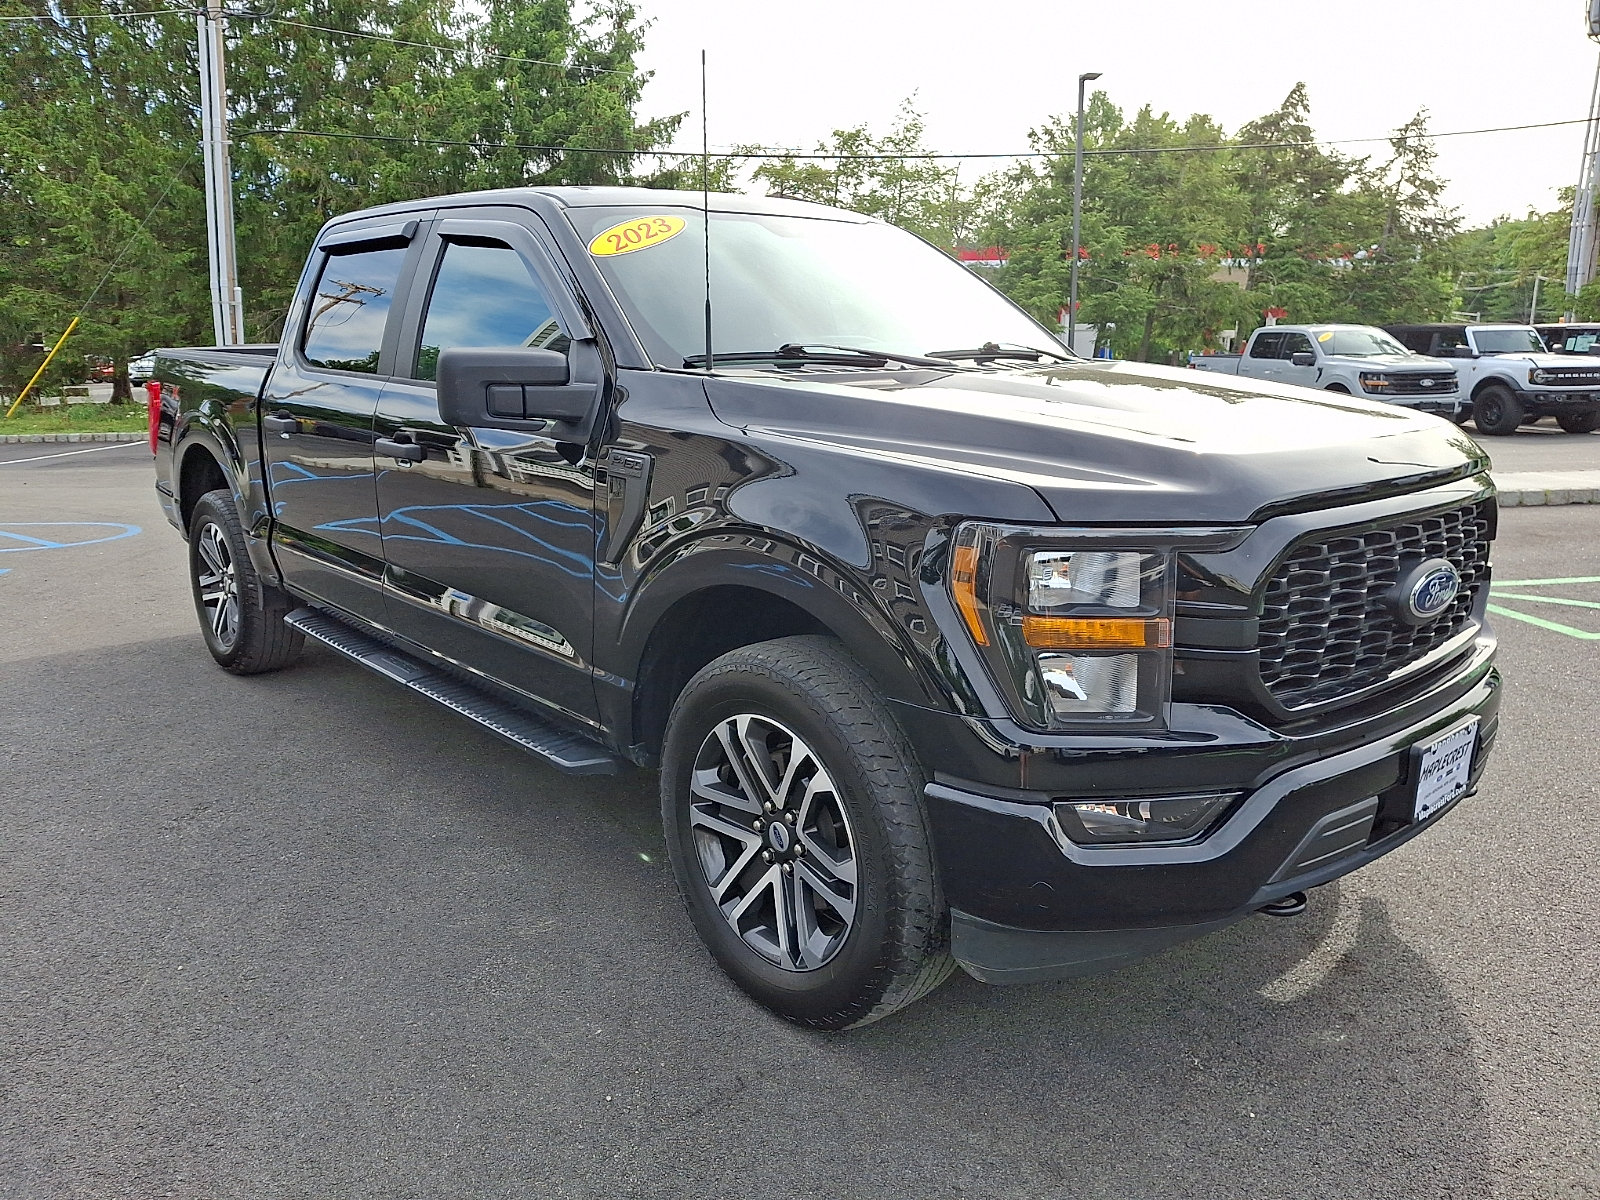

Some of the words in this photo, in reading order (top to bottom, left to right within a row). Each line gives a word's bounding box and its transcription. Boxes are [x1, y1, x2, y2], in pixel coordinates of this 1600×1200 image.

[607, 218, 671, 251] 2023
[1424, 574, 1453, 608] Ford
[1419, 740, 1472, 781] MAPLECREST
